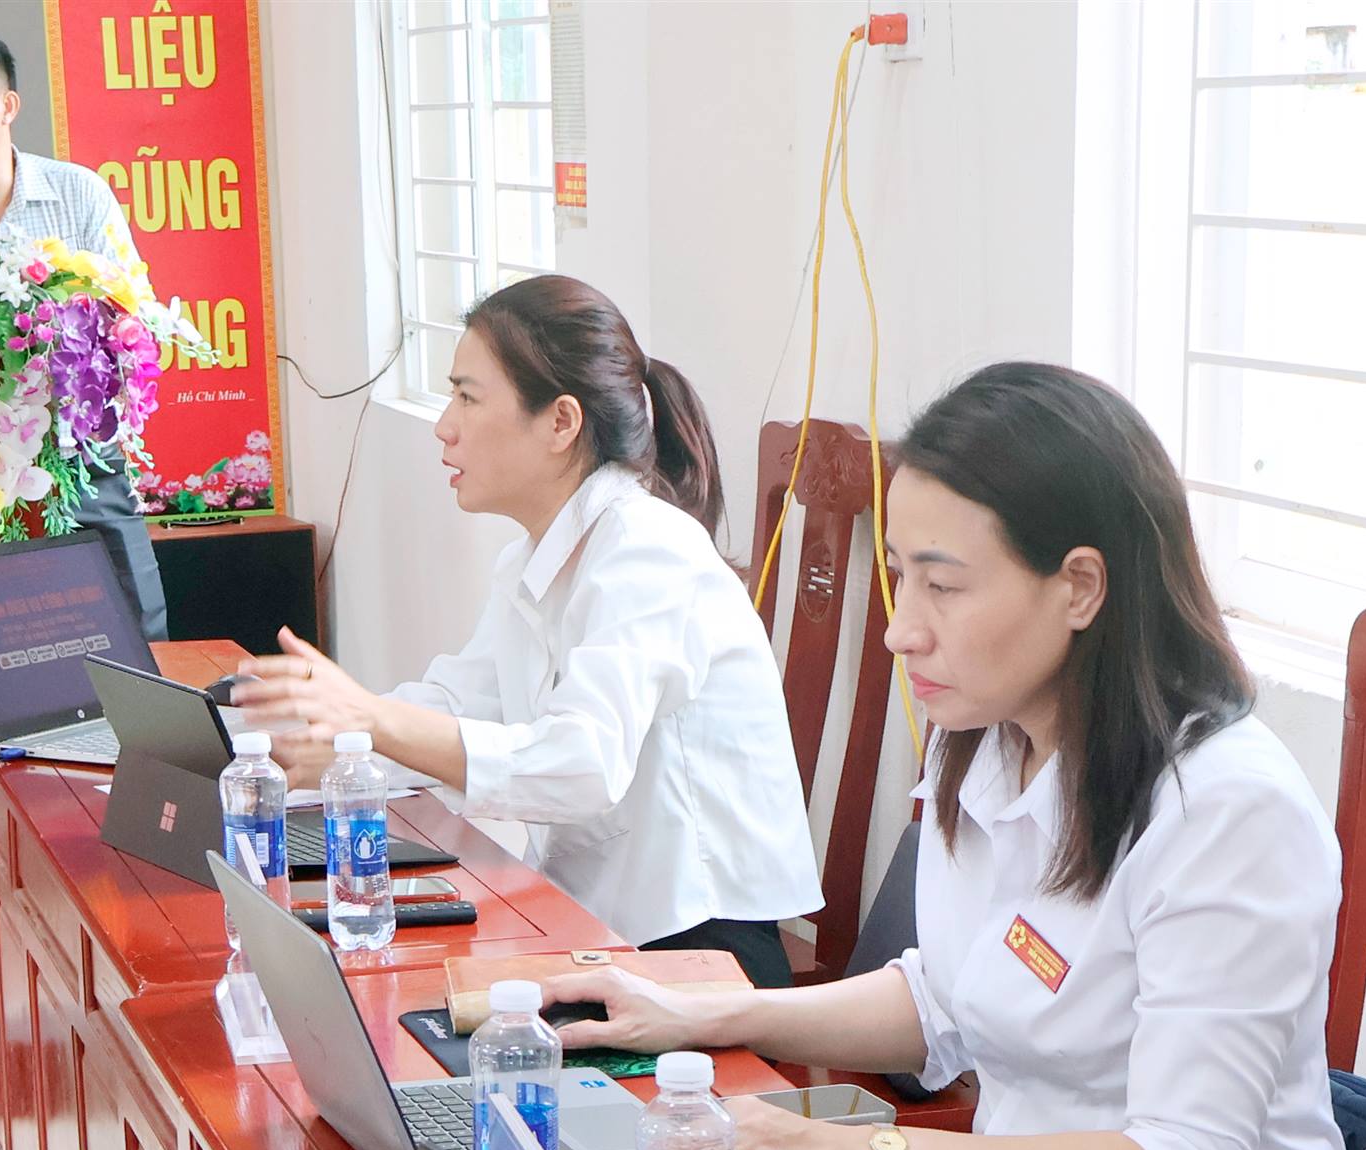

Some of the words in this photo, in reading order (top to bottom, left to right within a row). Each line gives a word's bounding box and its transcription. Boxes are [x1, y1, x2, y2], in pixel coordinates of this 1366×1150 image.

[101, 0, 216, 106] LIỆU
[196, 390, 216, 402] Chí
[218, 388, 246, 401] Minh
